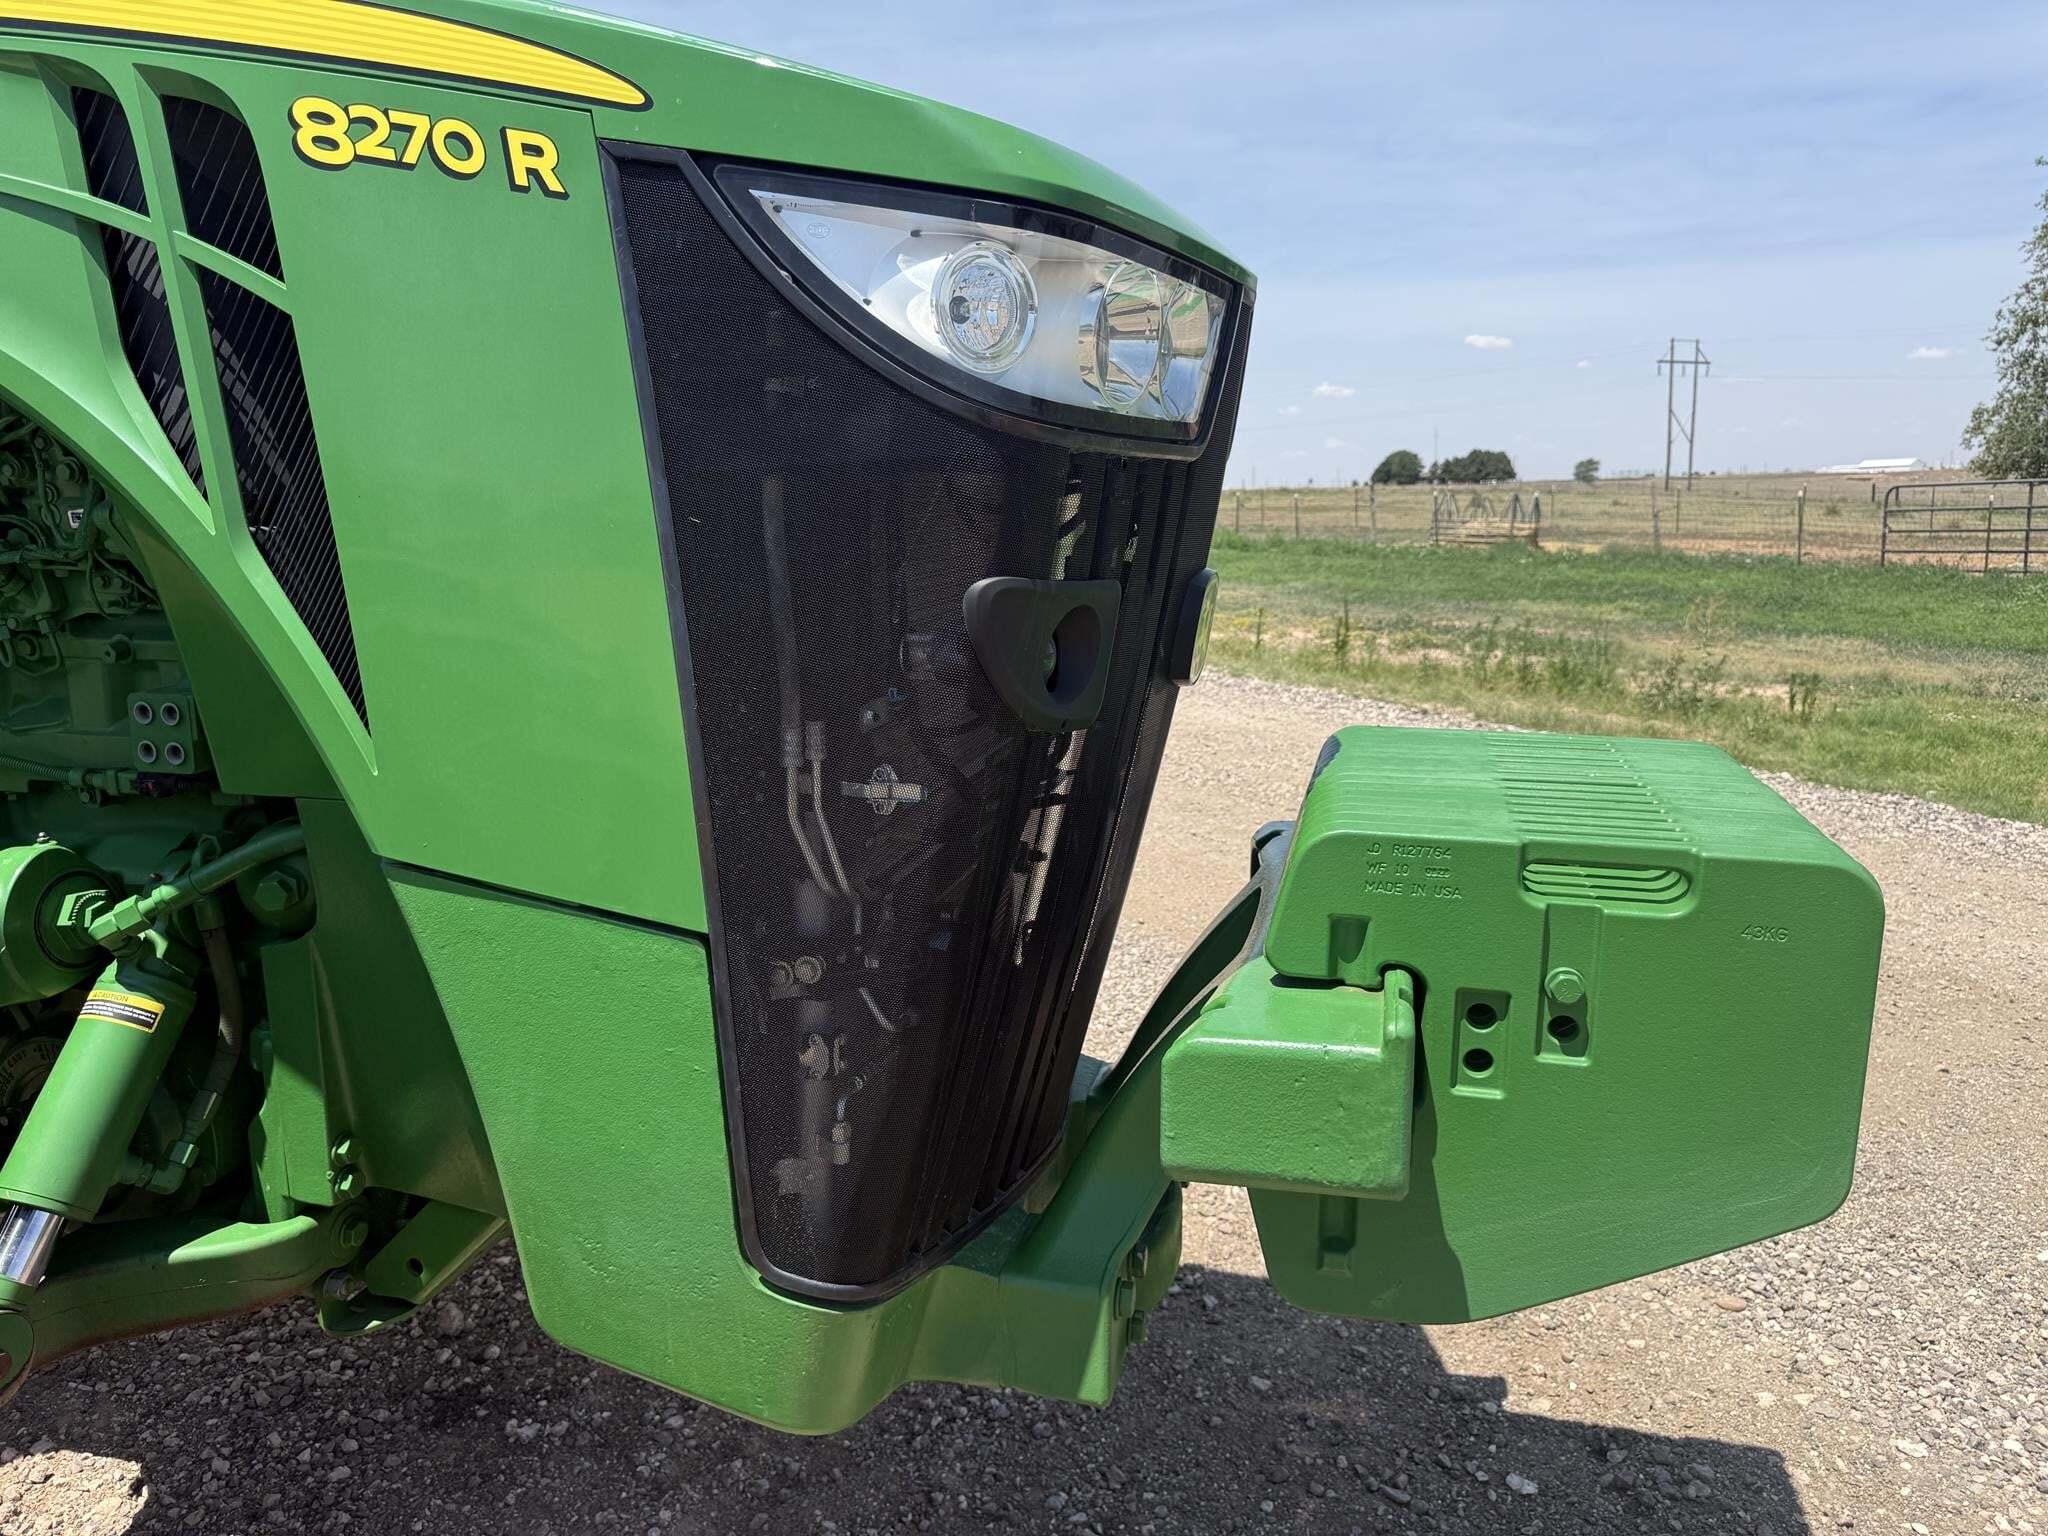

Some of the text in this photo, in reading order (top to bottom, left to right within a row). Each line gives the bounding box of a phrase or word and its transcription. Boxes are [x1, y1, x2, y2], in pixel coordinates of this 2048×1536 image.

[288, 95, 570, 201] 8270 R
[1392, 843, 1453, 860] R127764
[1366, 860, 1388, 875] WF
[1395, 863, 1410, 877] 10
[1364, 880, 1463, 900] MADE IN USA
[1741, 923, 1789, 942] 43KG
